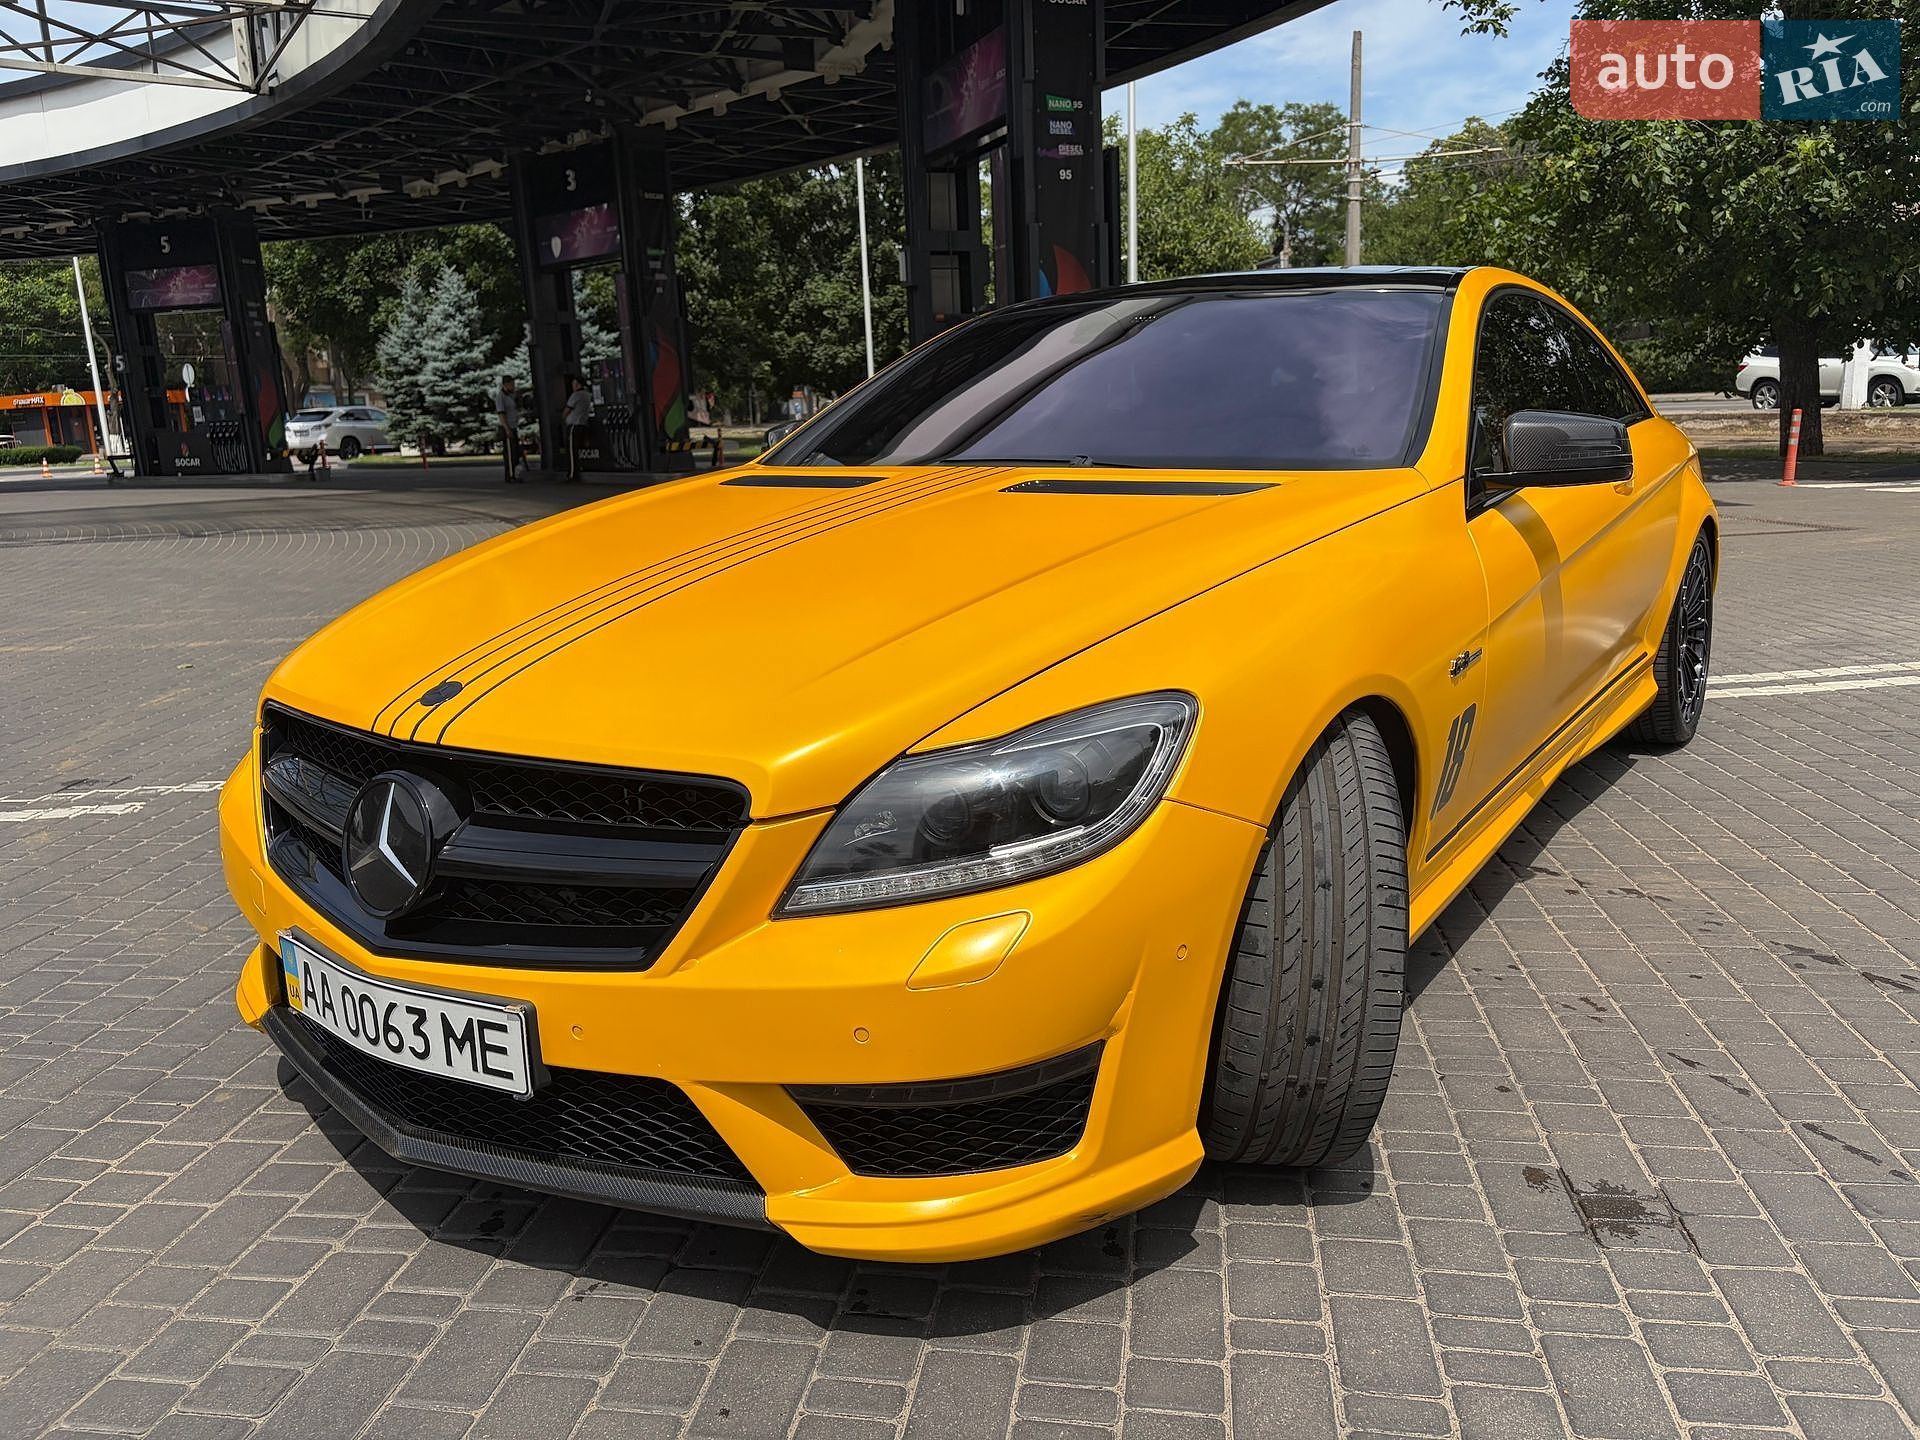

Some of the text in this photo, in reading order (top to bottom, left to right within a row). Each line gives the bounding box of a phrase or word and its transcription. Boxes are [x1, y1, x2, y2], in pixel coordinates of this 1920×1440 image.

[1048, 99, 1084, 109] NANO 95
[1049, 120, 1073, 129] NANO
[564, 168, 577, 192] 3
[1059, 169, 1073, 180] 95
[159, 234, 172, 254] 5
[115, 354, 126, 372] 5
[175, 457, 201, 467] SOCAR
[1430, 702, 1477, 821] 18
[288, 983, 302, 1002] UA
[302, 959, 515, 1081] AA 0063 ME
